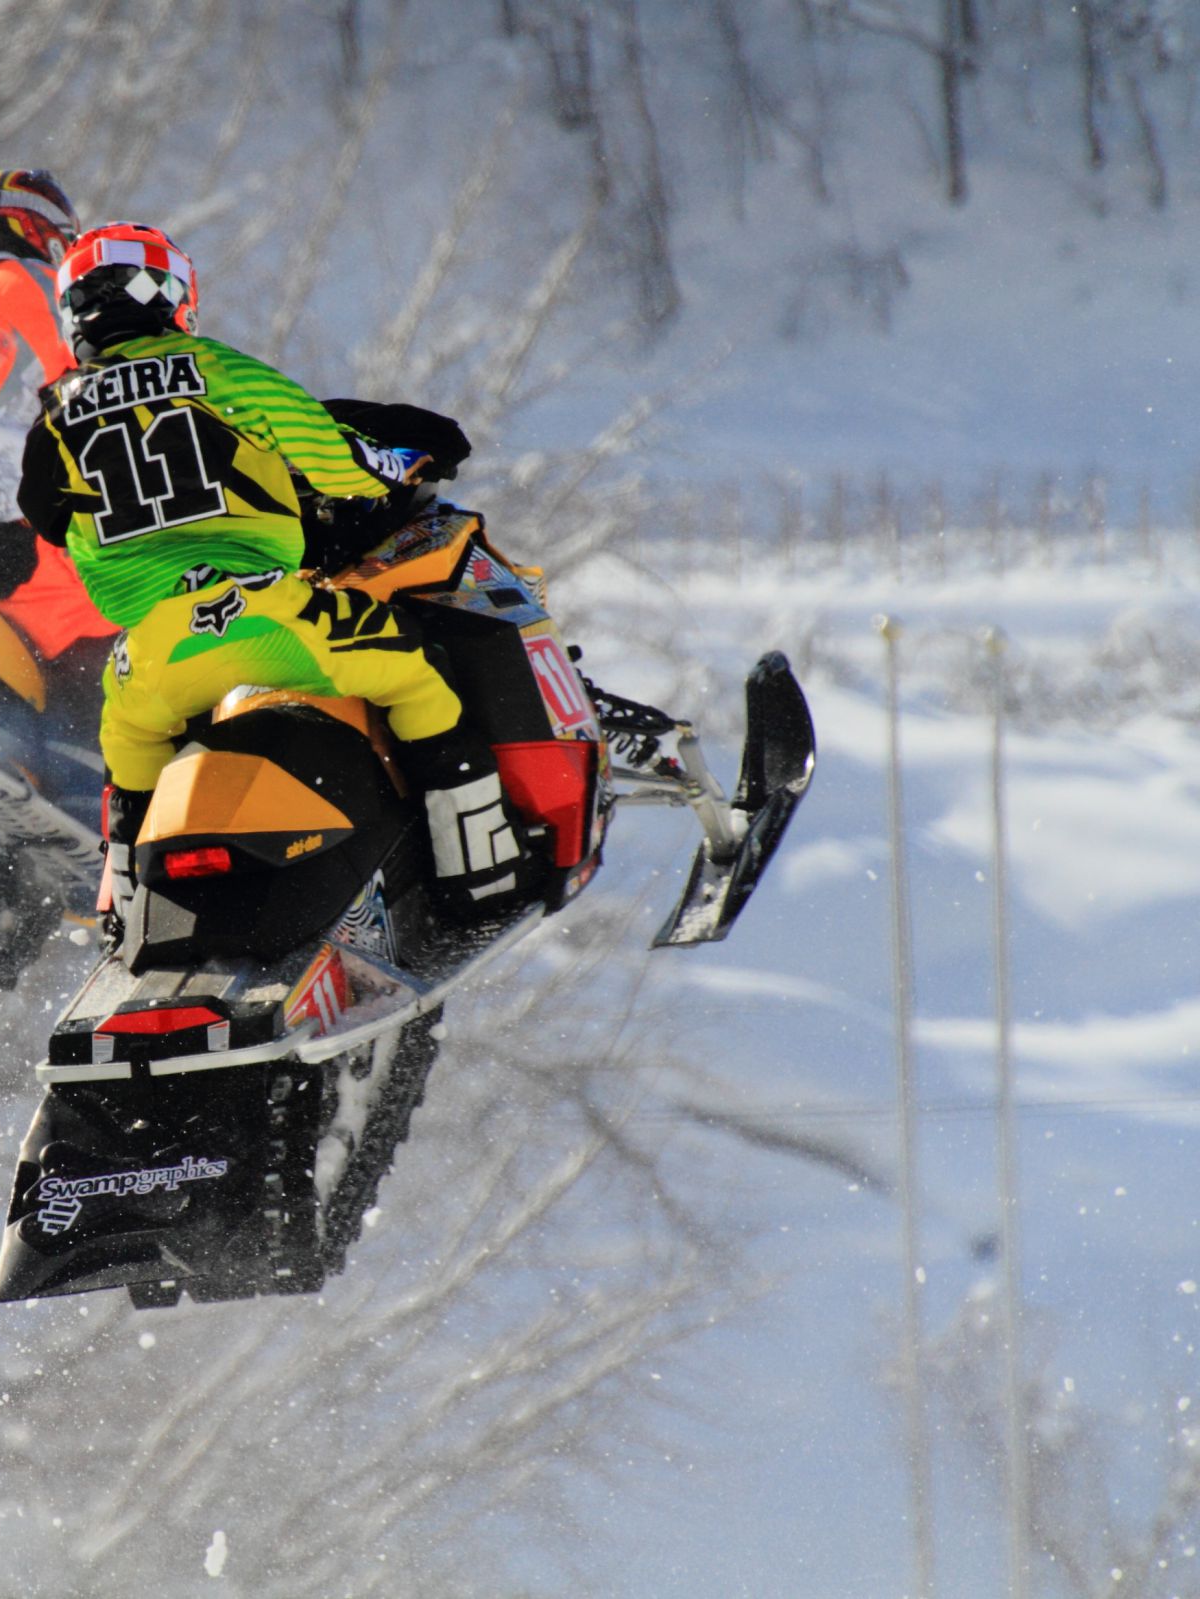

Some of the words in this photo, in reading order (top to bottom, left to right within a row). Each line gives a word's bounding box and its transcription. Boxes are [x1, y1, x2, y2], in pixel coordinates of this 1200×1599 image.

[62, 354, 207, 426] KEIRA
[79, 406, 228, 545] 11
[38, 1155, 228, 1202] Swampgraphics
